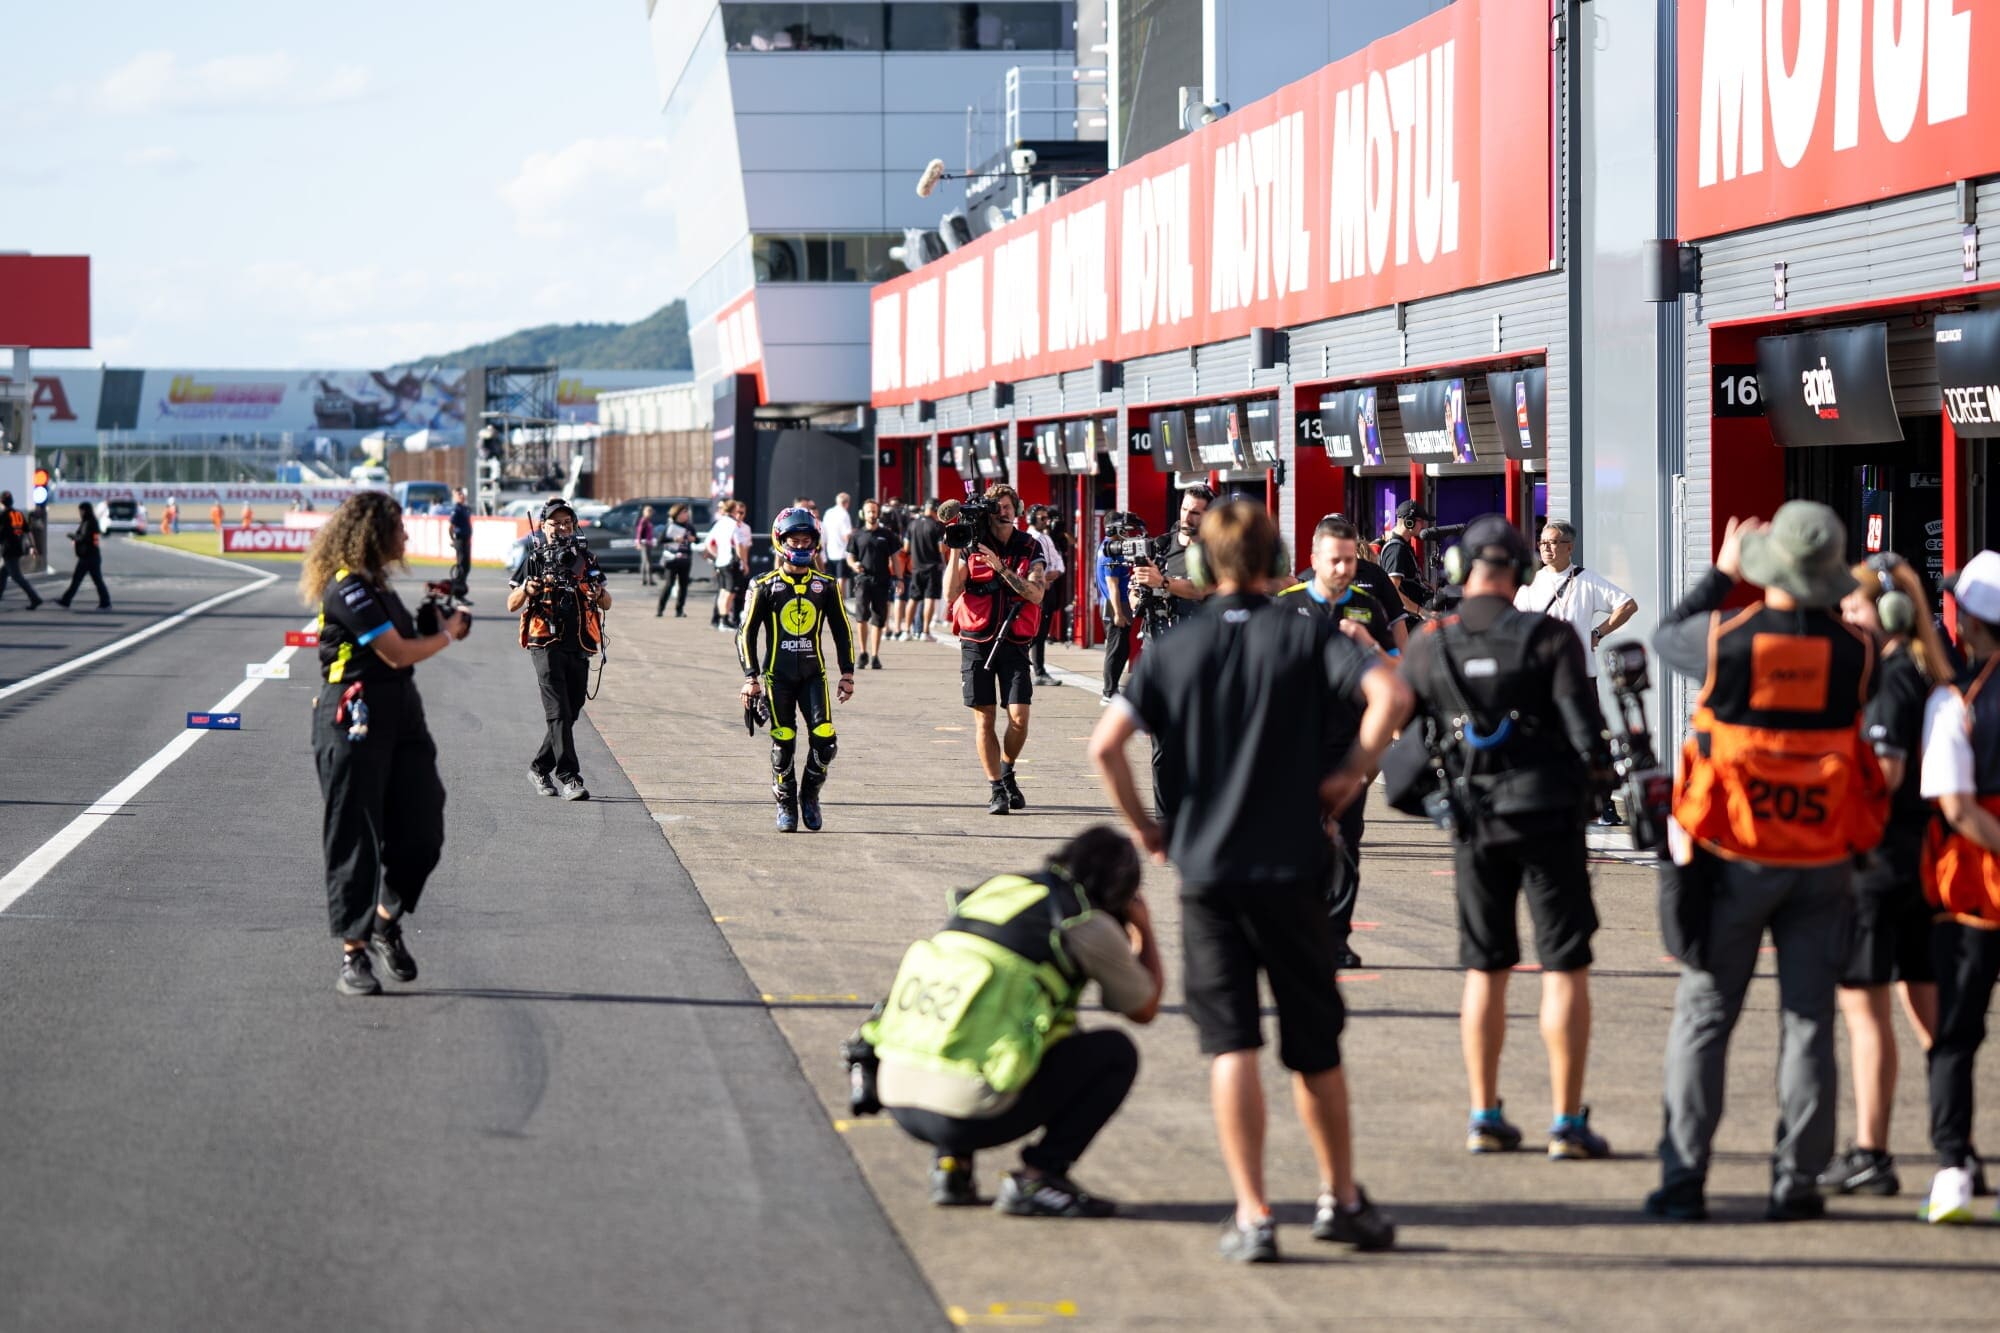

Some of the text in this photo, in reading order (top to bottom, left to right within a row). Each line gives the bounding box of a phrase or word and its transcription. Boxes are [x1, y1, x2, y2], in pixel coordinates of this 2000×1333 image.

[1329, 38, 1459, 284] MOTUL
[1211, 110, 1310, 313] MOTUL
[1121, 163, 1193, 335] MOTUL
[1721, 376, 1758, 405] 16
[1944, 387, 1990, 423] JORGE
[1300, 419, 1324, 438] 13
[1023, 442, 1034, 455] 7
[1131, 433, 1151, 450] 10
[883, 453, 891, 464] 1
[942, 451, 952, 463] 4
[58, 488, 134, 499] HONDA
[143, 488, 217, 499] HONDA
[226, 488, 305, 500] HONDA
[230, 530, 313, 548] MOTUL
[1867, 515, 1882, 551] 89
[781, 637, 813, 651] aprilia
[1748, 780, 1828, 825] 205
[898, 976, 960, 1021] 062
